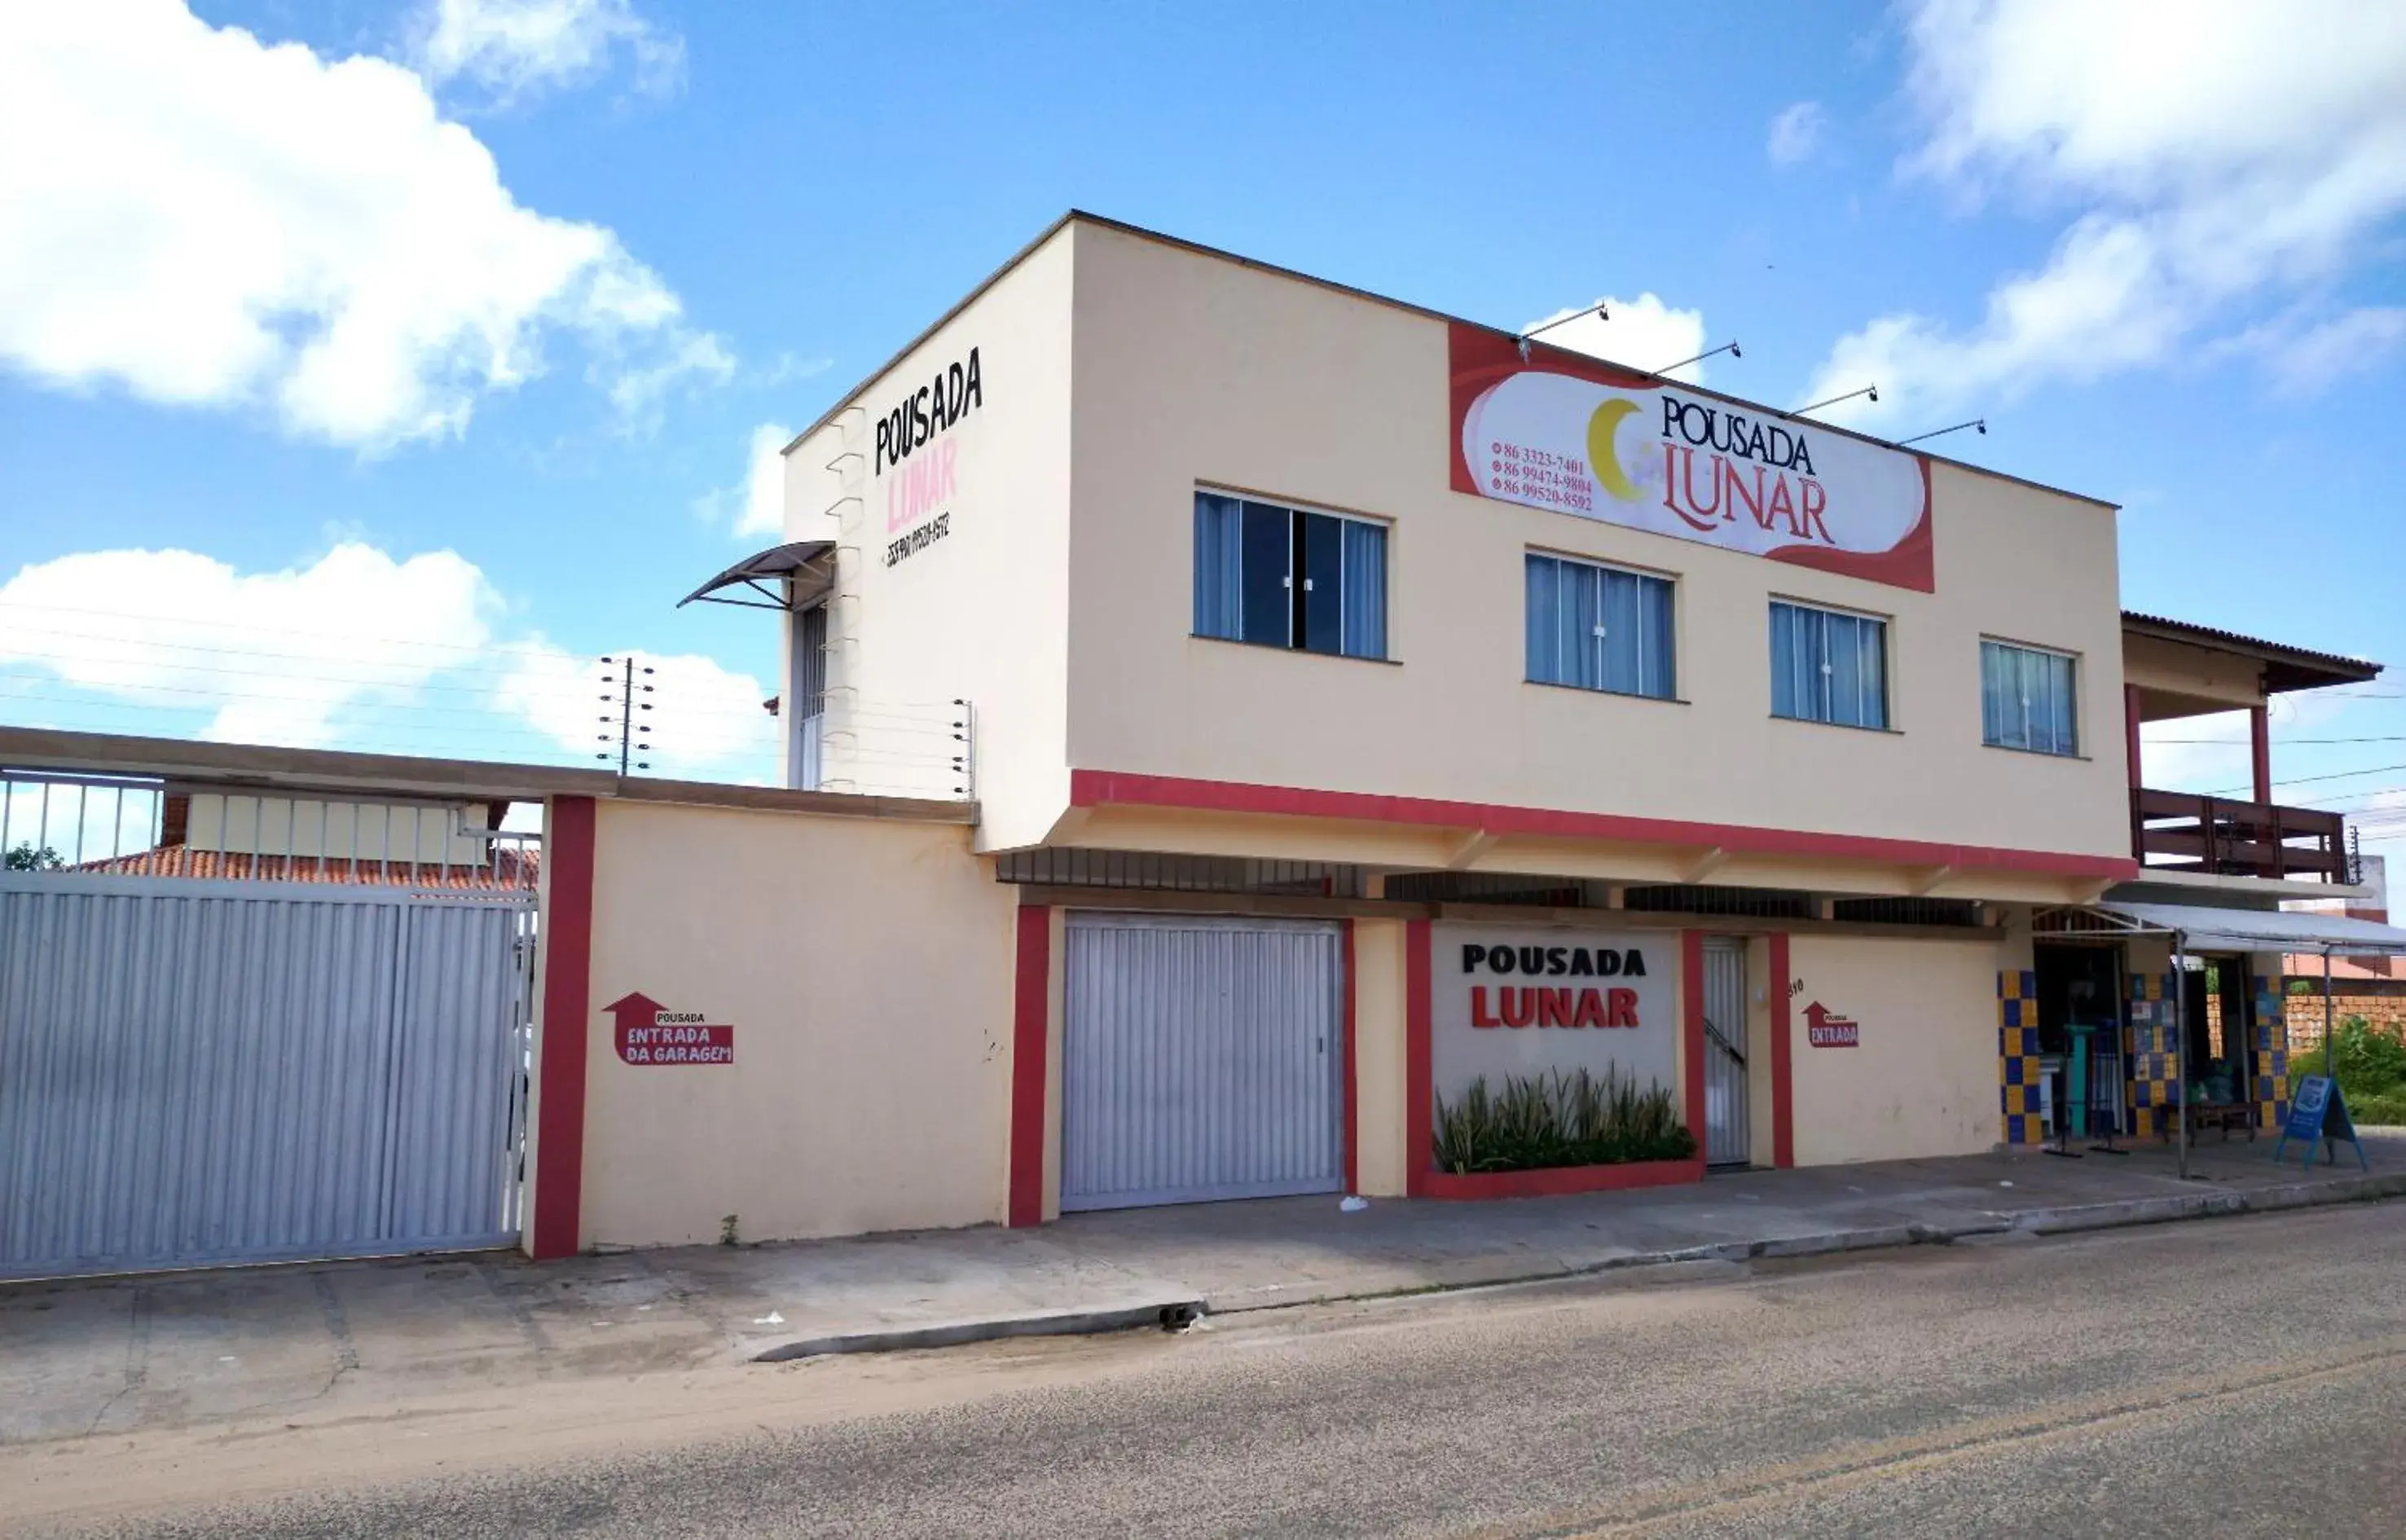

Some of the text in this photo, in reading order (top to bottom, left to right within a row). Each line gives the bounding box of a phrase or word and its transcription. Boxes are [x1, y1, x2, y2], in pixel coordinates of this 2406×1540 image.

[875, 345, 982, 477] POUSADA
[1661, 395, 1816, 476] POUSADA
[1504, 444, 1520, 460] 86
[1504, 461, 1520, 477] 86
[888, 436, 957, 534] LUNAR
[1504, 479, 1520, 495] 86
[1661, 442, 1836, 545] LUNAR
[1463, 944, 1647, 976] POUSADA
[1471, 985, 1640, 1028] LUNAR
[657, 1013, 706, 1023] POUSADA
[628, 1027, 710, 1044] ENTRADA
[1812, 1027, 1857, 1043] ENTRADA
[627, 1046, 732, 1063] DA GARAGEM
